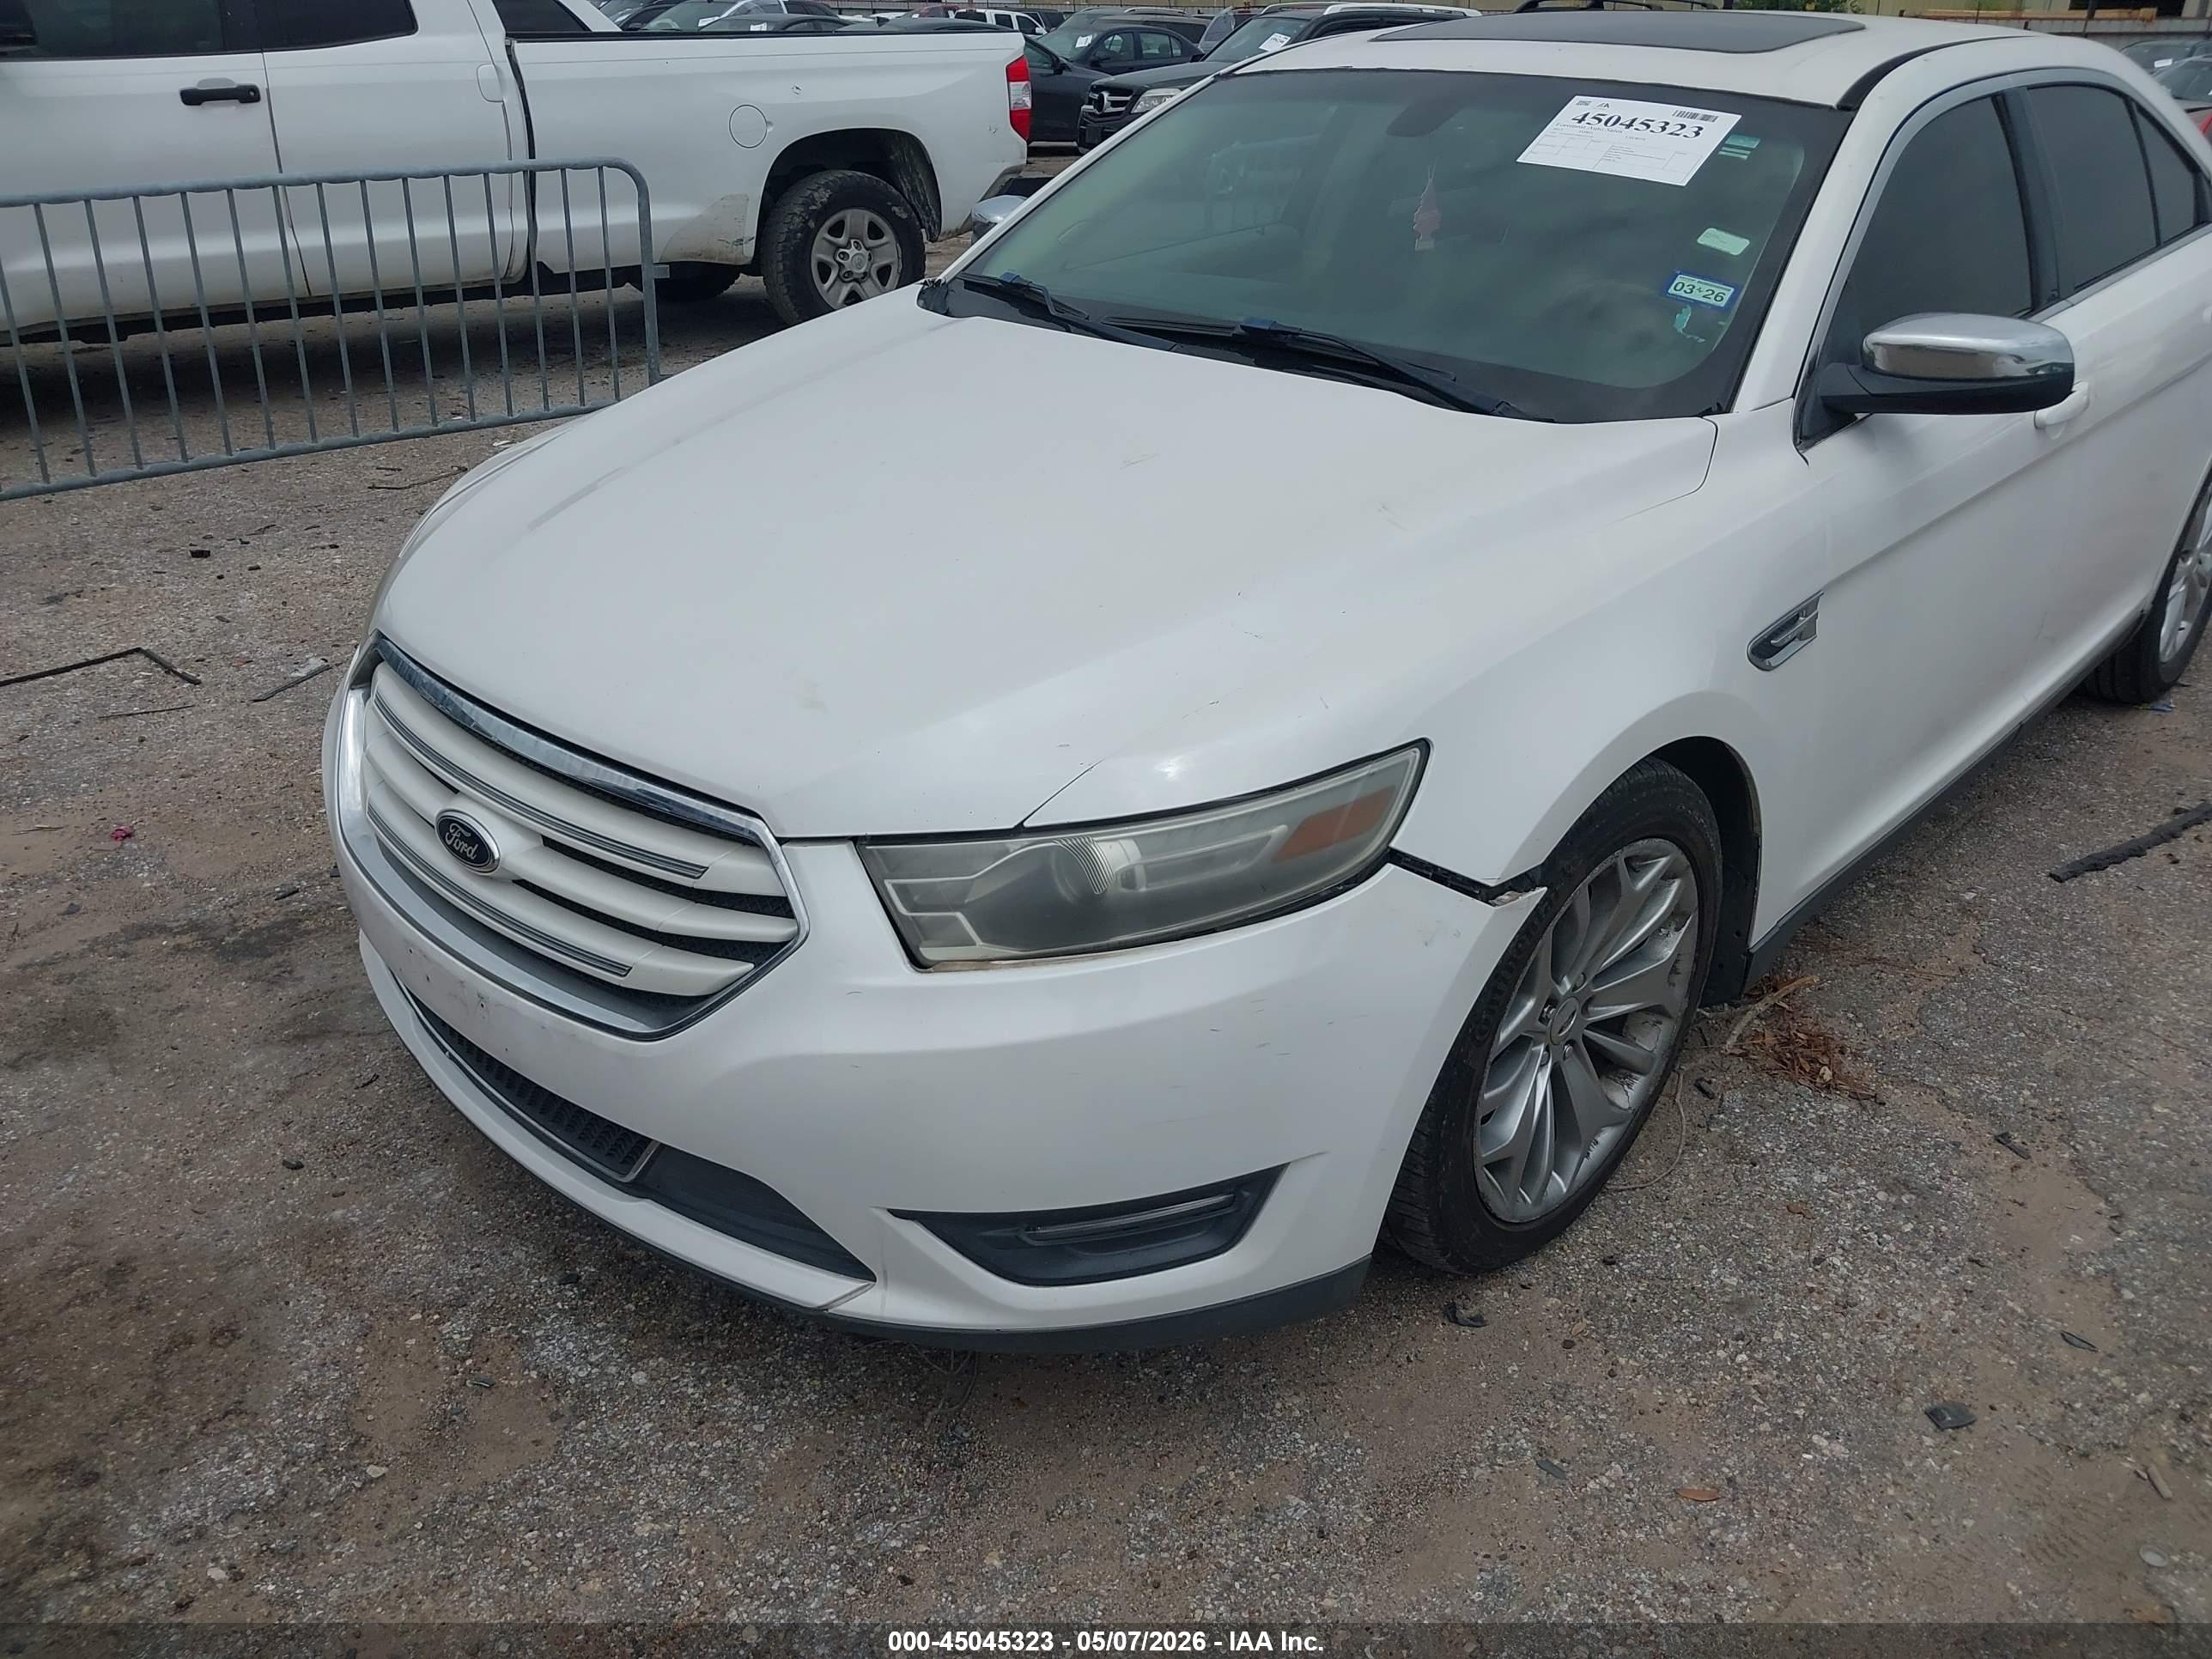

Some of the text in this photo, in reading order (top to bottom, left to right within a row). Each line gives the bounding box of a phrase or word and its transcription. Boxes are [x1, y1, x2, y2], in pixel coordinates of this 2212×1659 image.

[1571, 112, 1704, 138] 45045323
[1673, 282, 1696, 295] 03
[1702, 289, 1726, 302] 26
[445, 823, 479, 860] Ford
